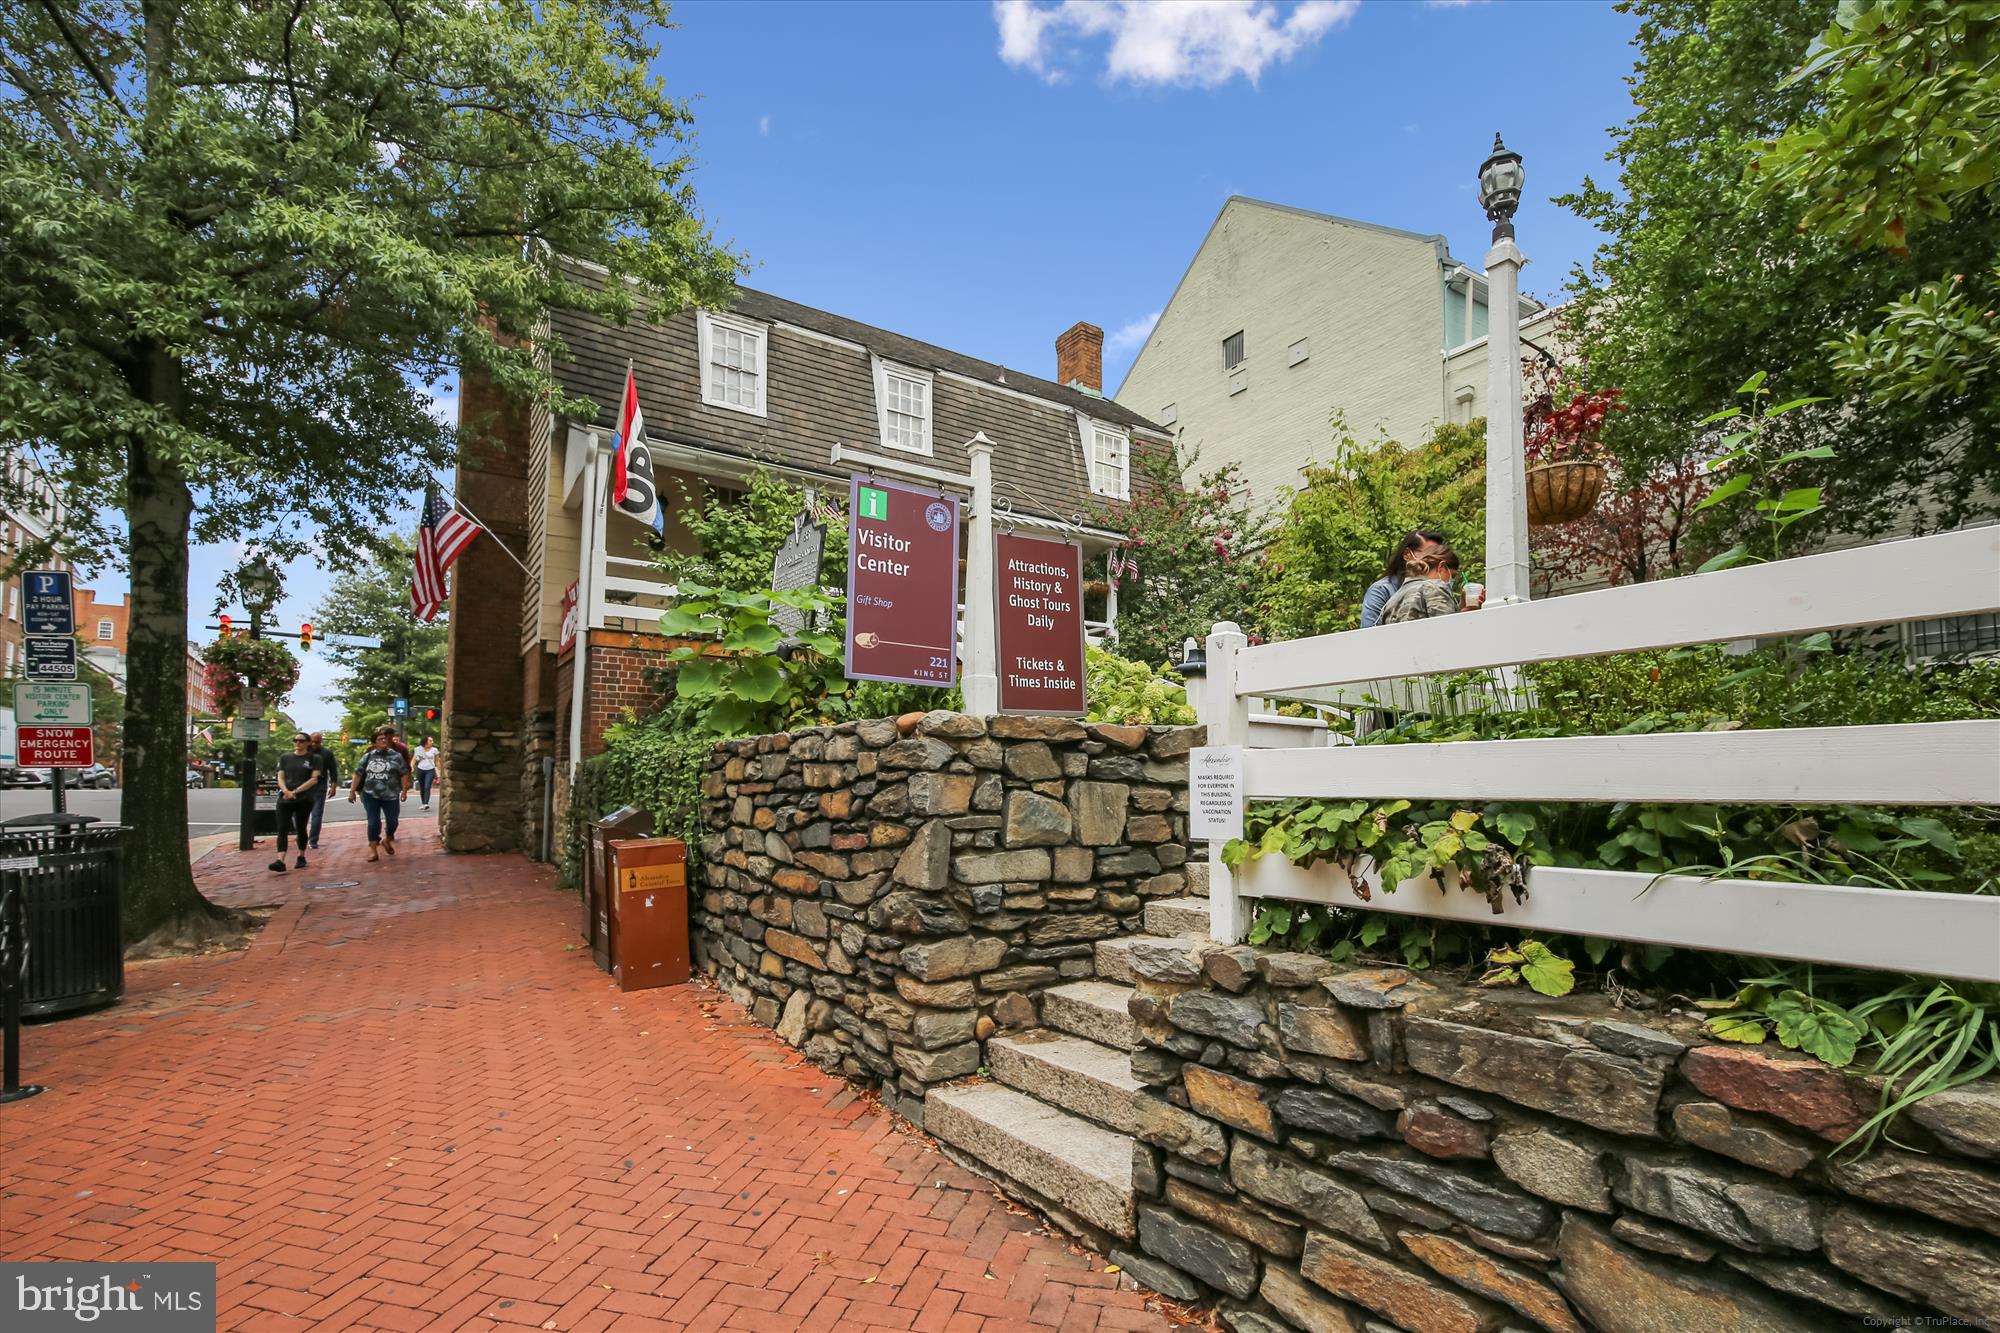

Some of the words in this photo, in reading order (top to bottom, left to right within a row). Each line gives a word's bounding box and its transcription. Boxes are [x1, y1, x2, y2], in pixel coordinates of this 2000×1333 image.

[858, 528, 911, 552] Visitor
[858, 554, 910, 577] Center
[1008, 558, 1070, 579] Attractions,
[39, 575, 54, 593] P
[1014, 576, 1051, 595] History
[1054, 582, 1062, 594] &
[856, 594, 872, 606] Gift
[873, 596, 893, 609] Shop
[1009, 594, 1040, 609] Ghost
[1042, 598, 1070, 612] Tours
[1028, 614, 1054, 630] Daily
[40, 664, 73, 672] 44505
[930, 656, 948, 668] 221
[1016, 656, 1054, 672] Tickets
[1056, 659, 1065, 672] &
[914, 669, 934, 678] KING
[938, 670, 948, 678] ST
[1008, 674, 1040, 688] Times
[1044, 676, 1076, 690] Inside
[36, 729, 74, 738] SNOW
[20, 740, 89, 748] EMERGENCY
[34, 750, 78, 758] ROUTE
